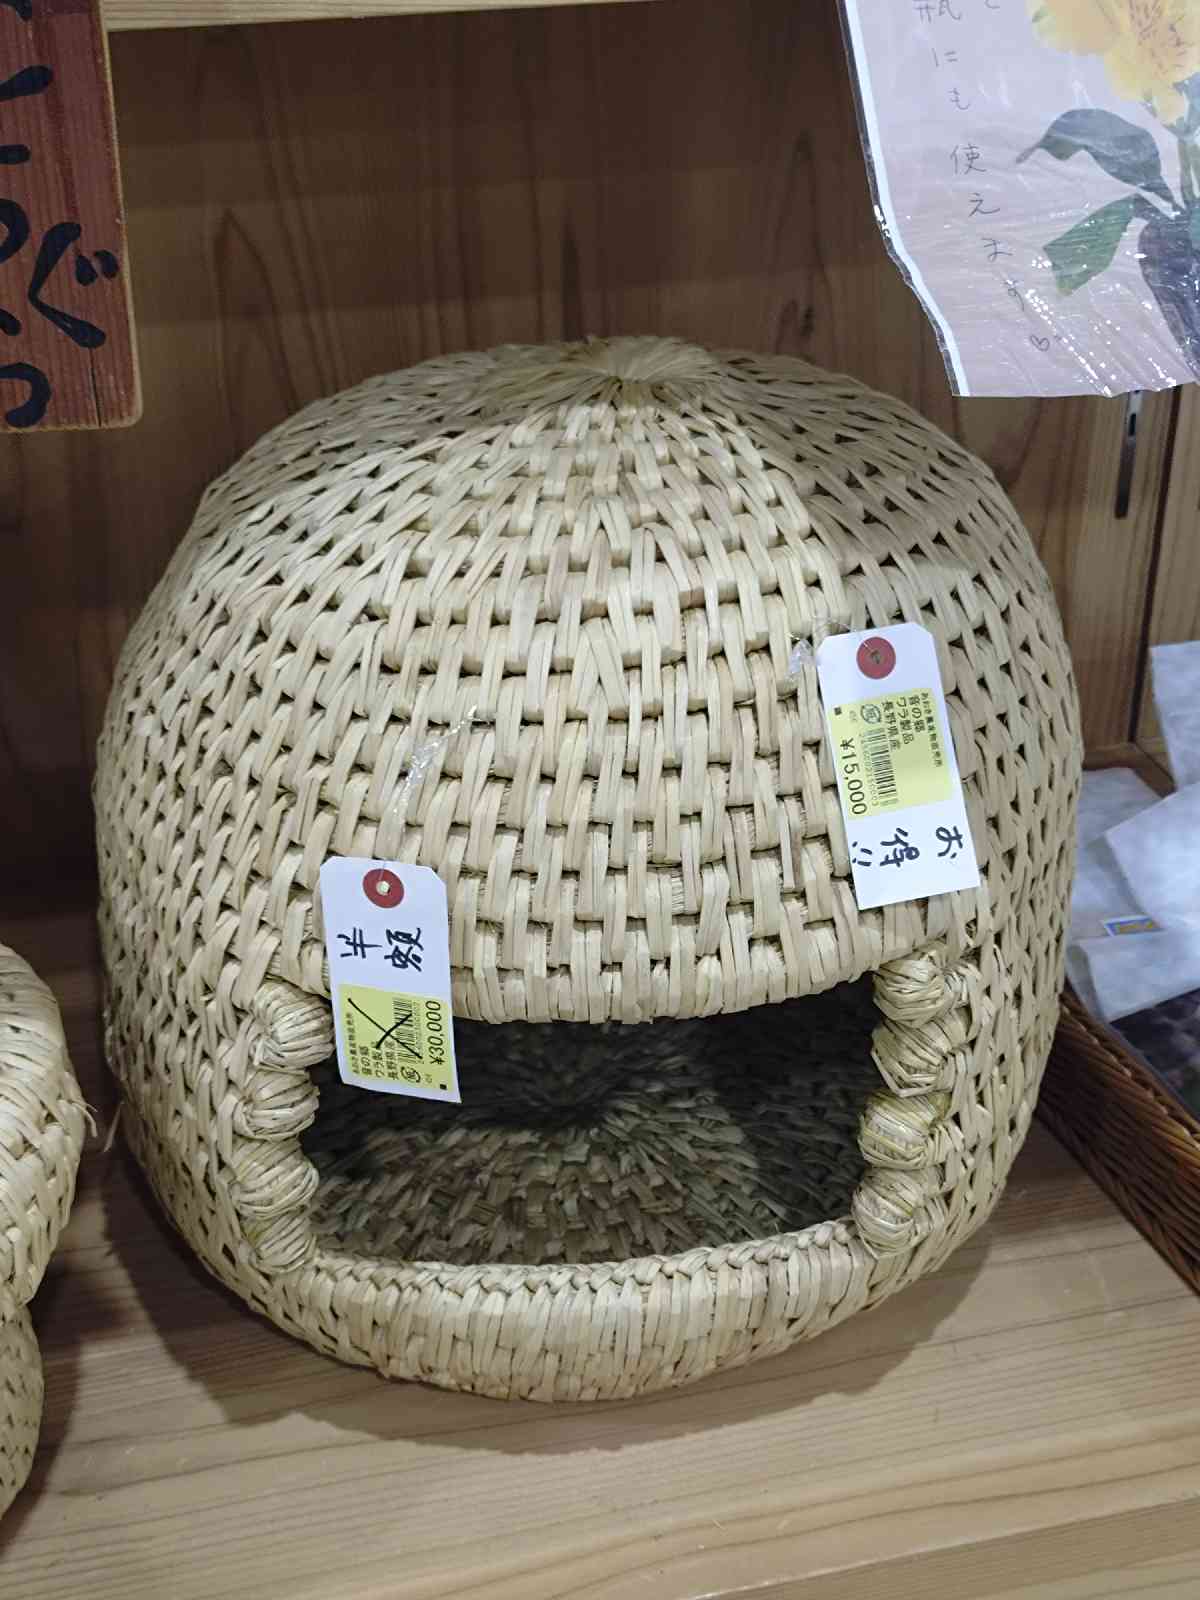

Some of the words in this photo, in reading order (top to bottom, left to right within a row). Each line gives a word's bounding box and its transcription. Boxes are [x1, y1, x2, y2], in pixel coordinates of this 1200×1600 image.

[882, 700, 901, 751] 長野県産
[896, 696, 914, 745] ワラ製品
[839, 737, 867, 815] ¥15,000
[337, 927, 424, 972] 半額
[425, 1000, 443, 1065] ¥30,000
